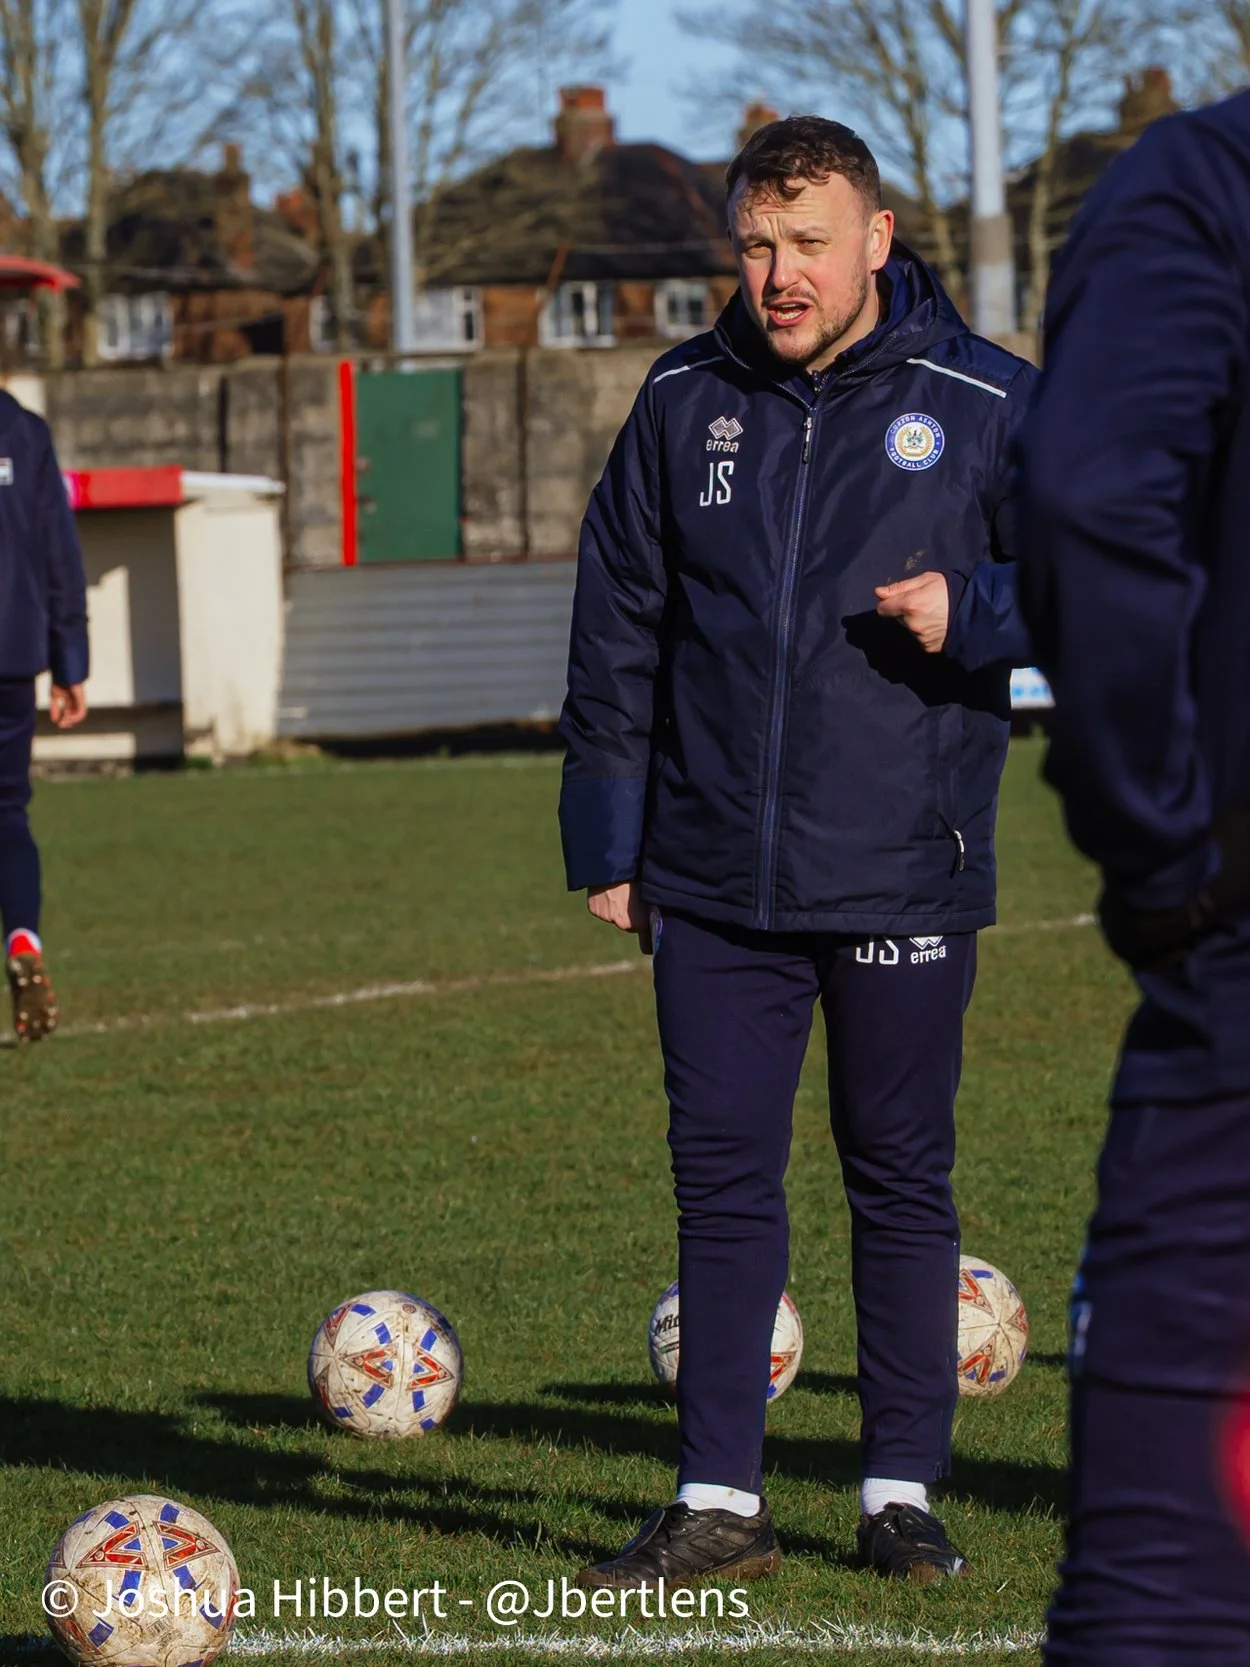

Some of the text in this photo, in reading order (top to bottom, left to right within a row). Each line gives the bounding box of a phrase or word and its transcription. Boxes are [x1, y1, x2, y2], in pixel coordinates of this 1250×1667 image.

[918, 416, 941, 438] ASHTON
[889, 447, 939, 468] FOOTBALL CLUB
[699, 460, 735, 507] JS
